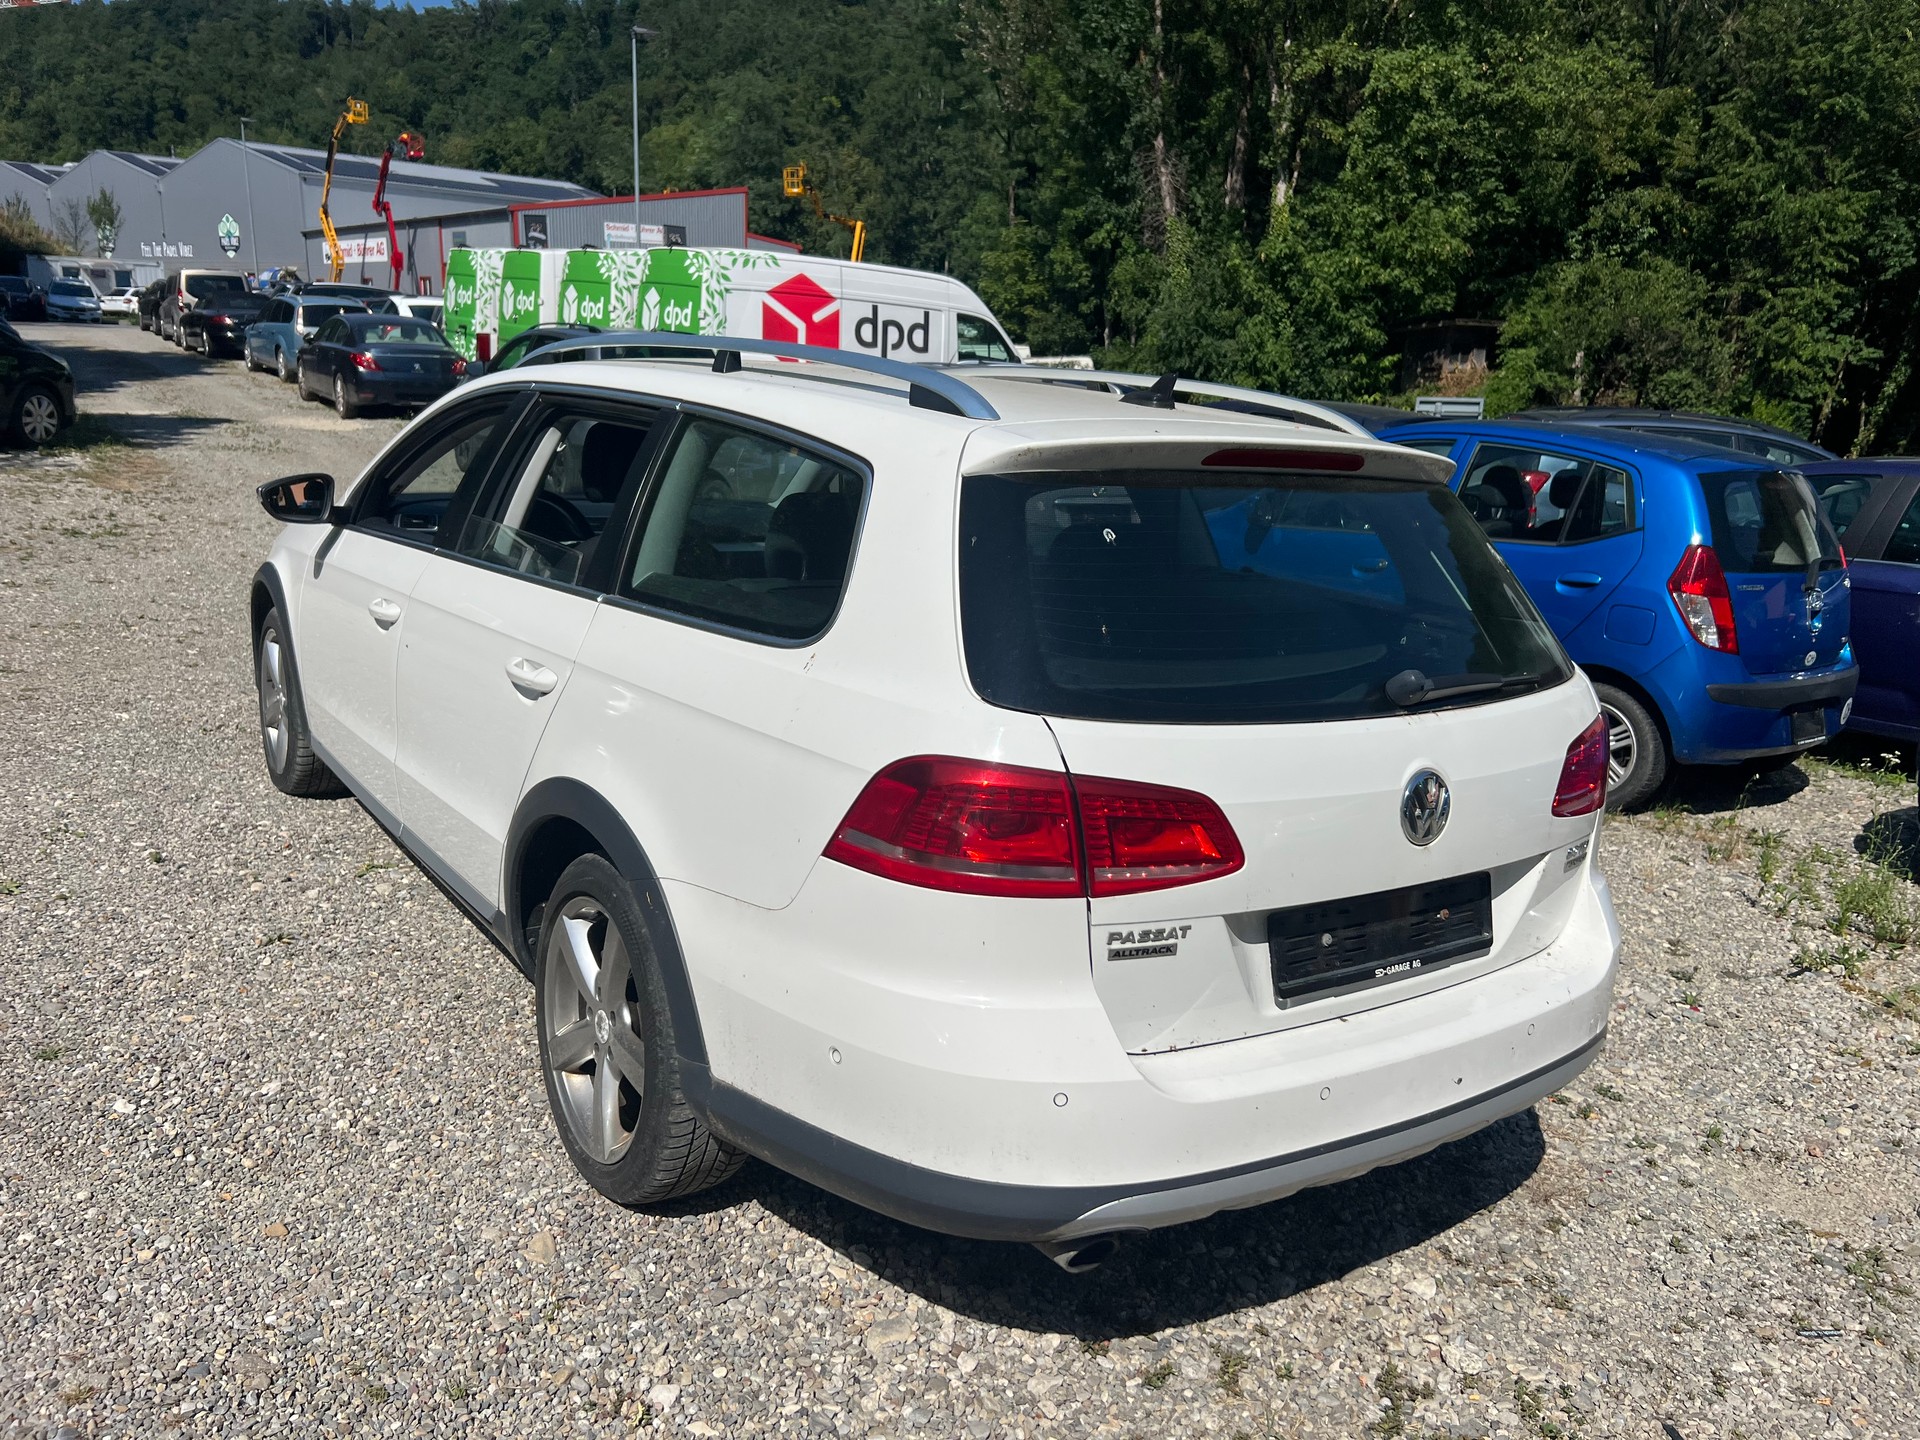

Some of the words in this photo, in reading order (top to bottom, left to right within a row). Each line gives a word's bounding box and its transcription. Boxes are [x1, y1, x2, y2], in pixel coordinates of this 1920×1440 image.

[376, 241, 385, 256] AG
[457, 284, 473, 307] dpd
[516, 289, 535, 315] dpd
[580, 294, 605, 323] dpd
[663, 298, 693, 331] dpd
[854, 304, 930, 359] dpd
[1106, 924, 1192, 946] PASSAT
[1111, 945, 1174, 958] ALLTRACK
[1412, 959, 1422, 969] AG
